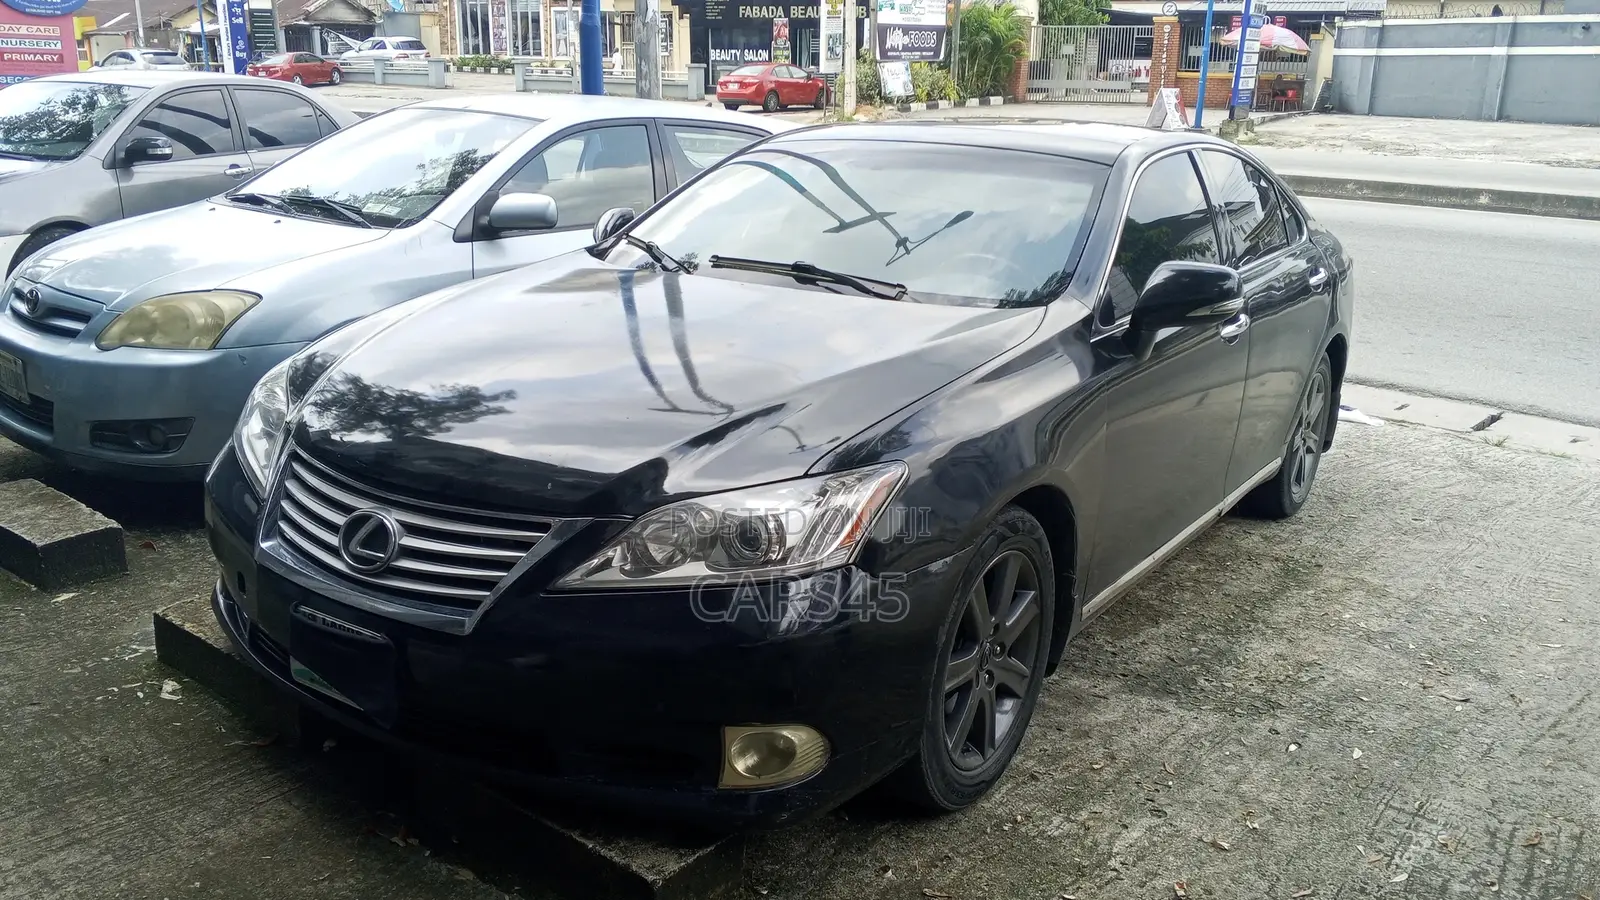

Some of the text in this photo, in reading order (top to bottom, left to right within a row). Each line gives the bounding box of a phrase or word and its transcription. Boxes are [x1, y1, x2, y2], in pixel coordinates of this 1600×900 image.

[739, 6, 785, 18] FABADA
[791, 6, 821, 18] BEAU
[0, 25, 60, 35] DAY CARE
[0, 39, 60, 48] NURSERY
[908, 30, 937, 48] FOODS
[3, 53, 60, 62] PRIMARY
[235, 50, 247, 59] Buy
[711, 49, 741, 61] BEAUTY
[744, 50, 769, 61] SALON
